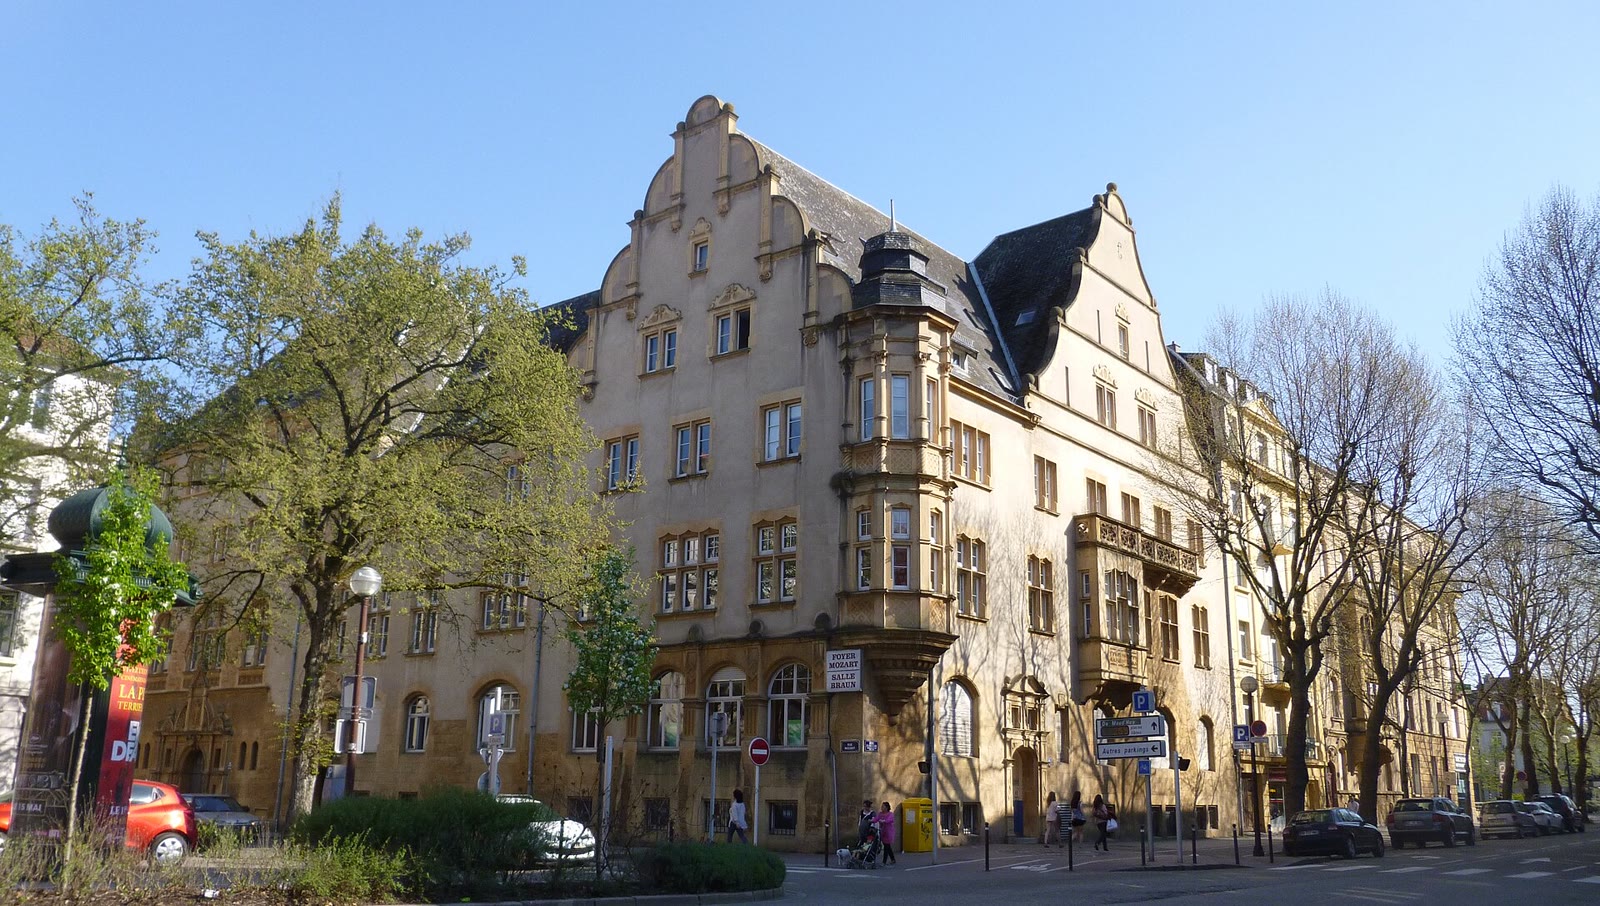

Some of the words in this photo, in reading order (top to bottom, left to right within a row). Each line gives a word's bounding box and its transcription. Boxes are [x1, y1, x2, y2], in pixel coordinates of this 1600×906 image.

[829, 661, 858, 669] MOZART
[831, 673, 855, 681] SALLE
[831, 681, 856, 689] BRAUN
[118, 684, 136, 699] LA
[1137, 695, 1146, 709] P
[493, 717, 500, 731] P
[1237, 728, 1246, 740] P
[1124, 746, 1149, 755] parkings
